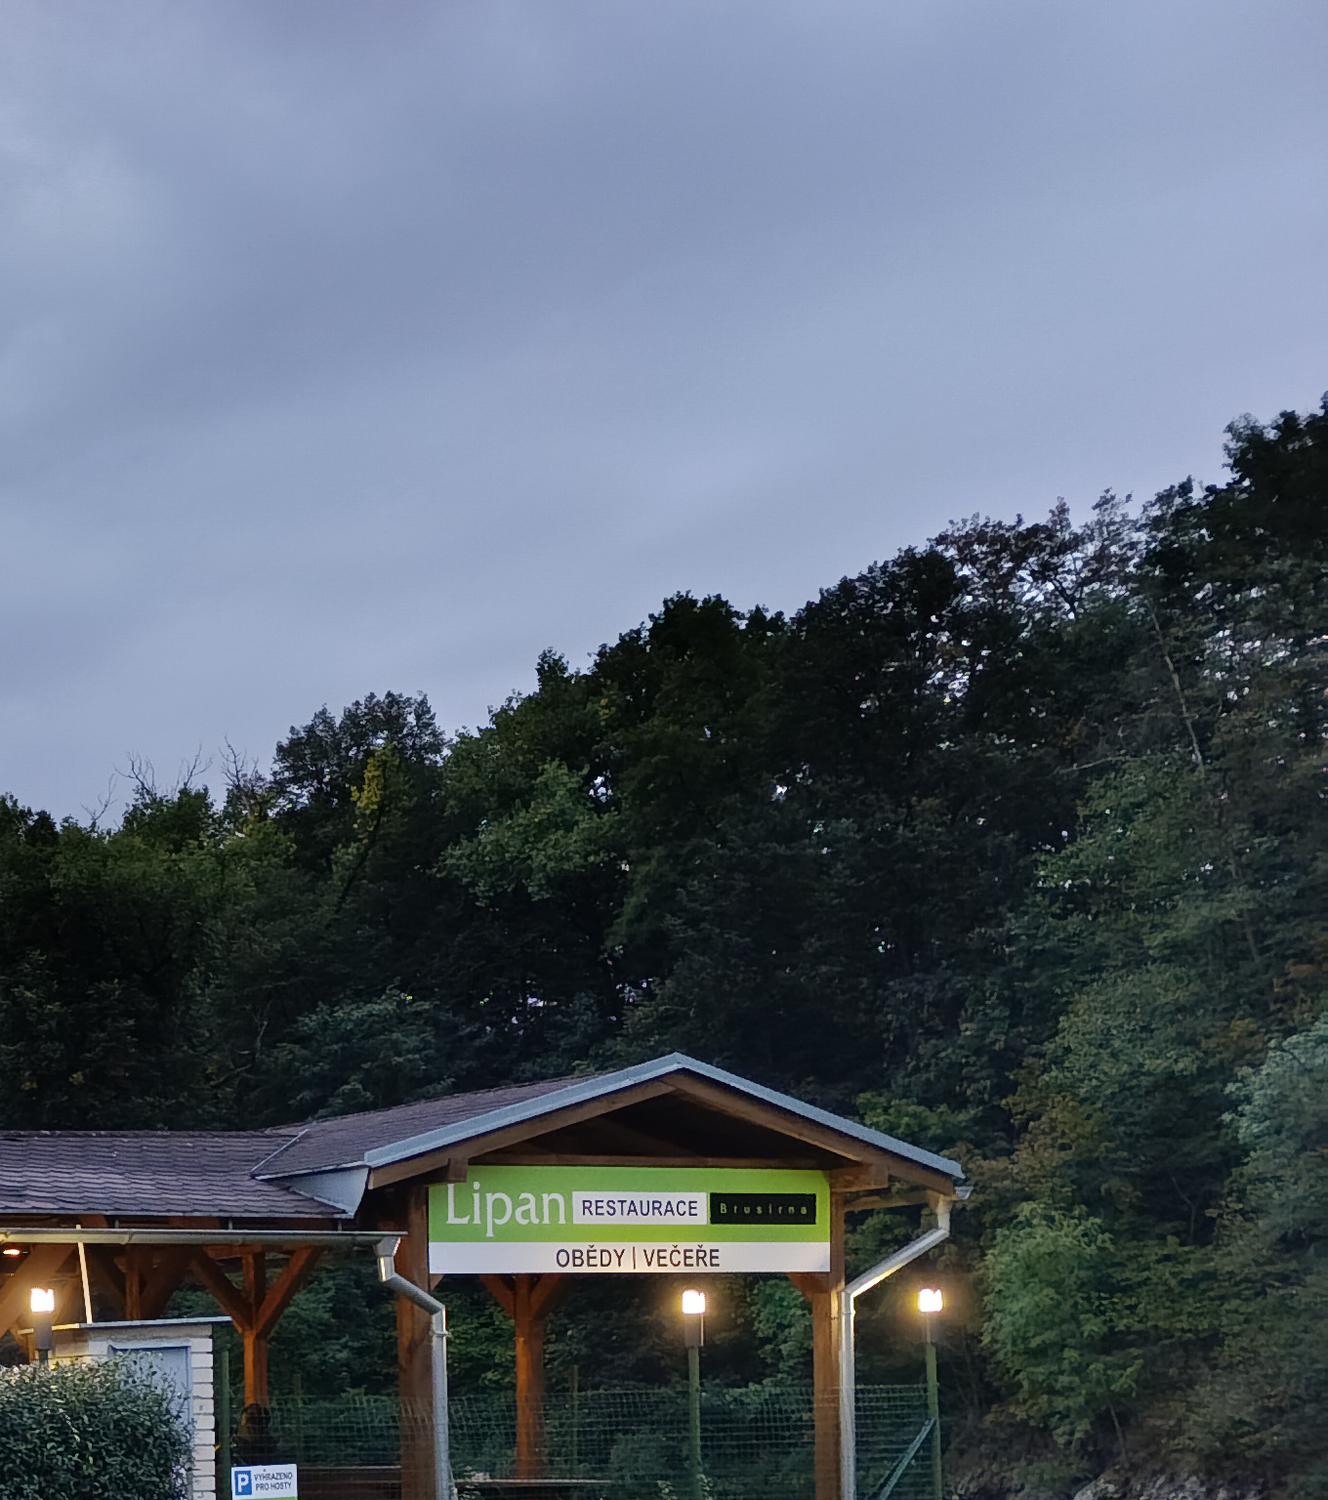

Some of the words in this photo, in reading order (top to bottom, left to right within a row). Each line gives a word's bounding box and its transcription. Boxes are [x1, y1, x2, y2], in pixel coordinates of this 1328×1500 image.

[446, 1181, 566, 1238] Lipan
[582, 1199, 699, 1217] RESTAURACE
[555, 1244, 626, 1268] OBĚDY
[643, 1244, 721, 1268] VEČEŘE
[237, 1473, 250, 1493] P
